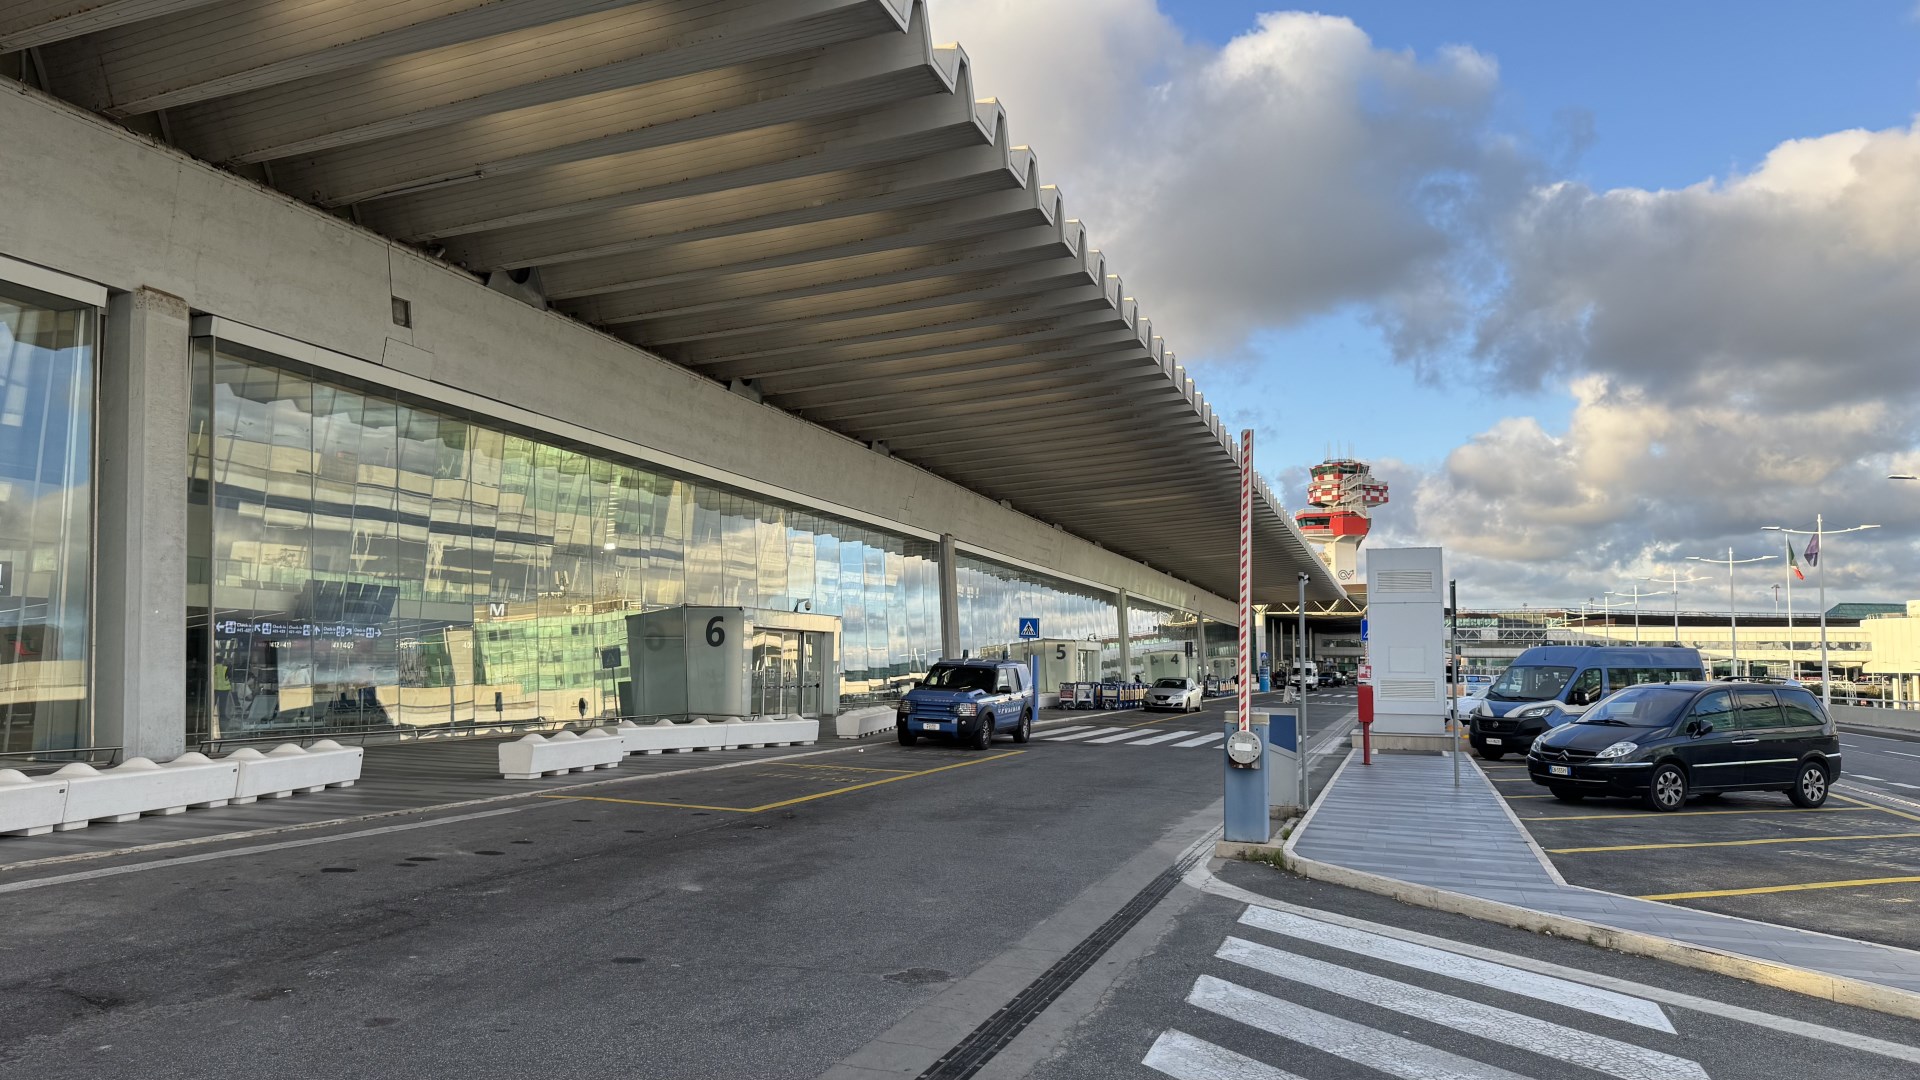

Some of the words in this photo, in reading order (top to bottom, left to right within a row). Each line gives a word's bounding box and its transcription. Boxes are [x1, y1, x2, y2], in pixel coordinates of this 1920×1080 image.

[490, 603, 505, 616] M
[706, 616, 725, 647] 6
[1056, 643, 1066, 660] 5
[1170, 653, 1179, 665] 4
[1230, 658, 1236, 668] 3
